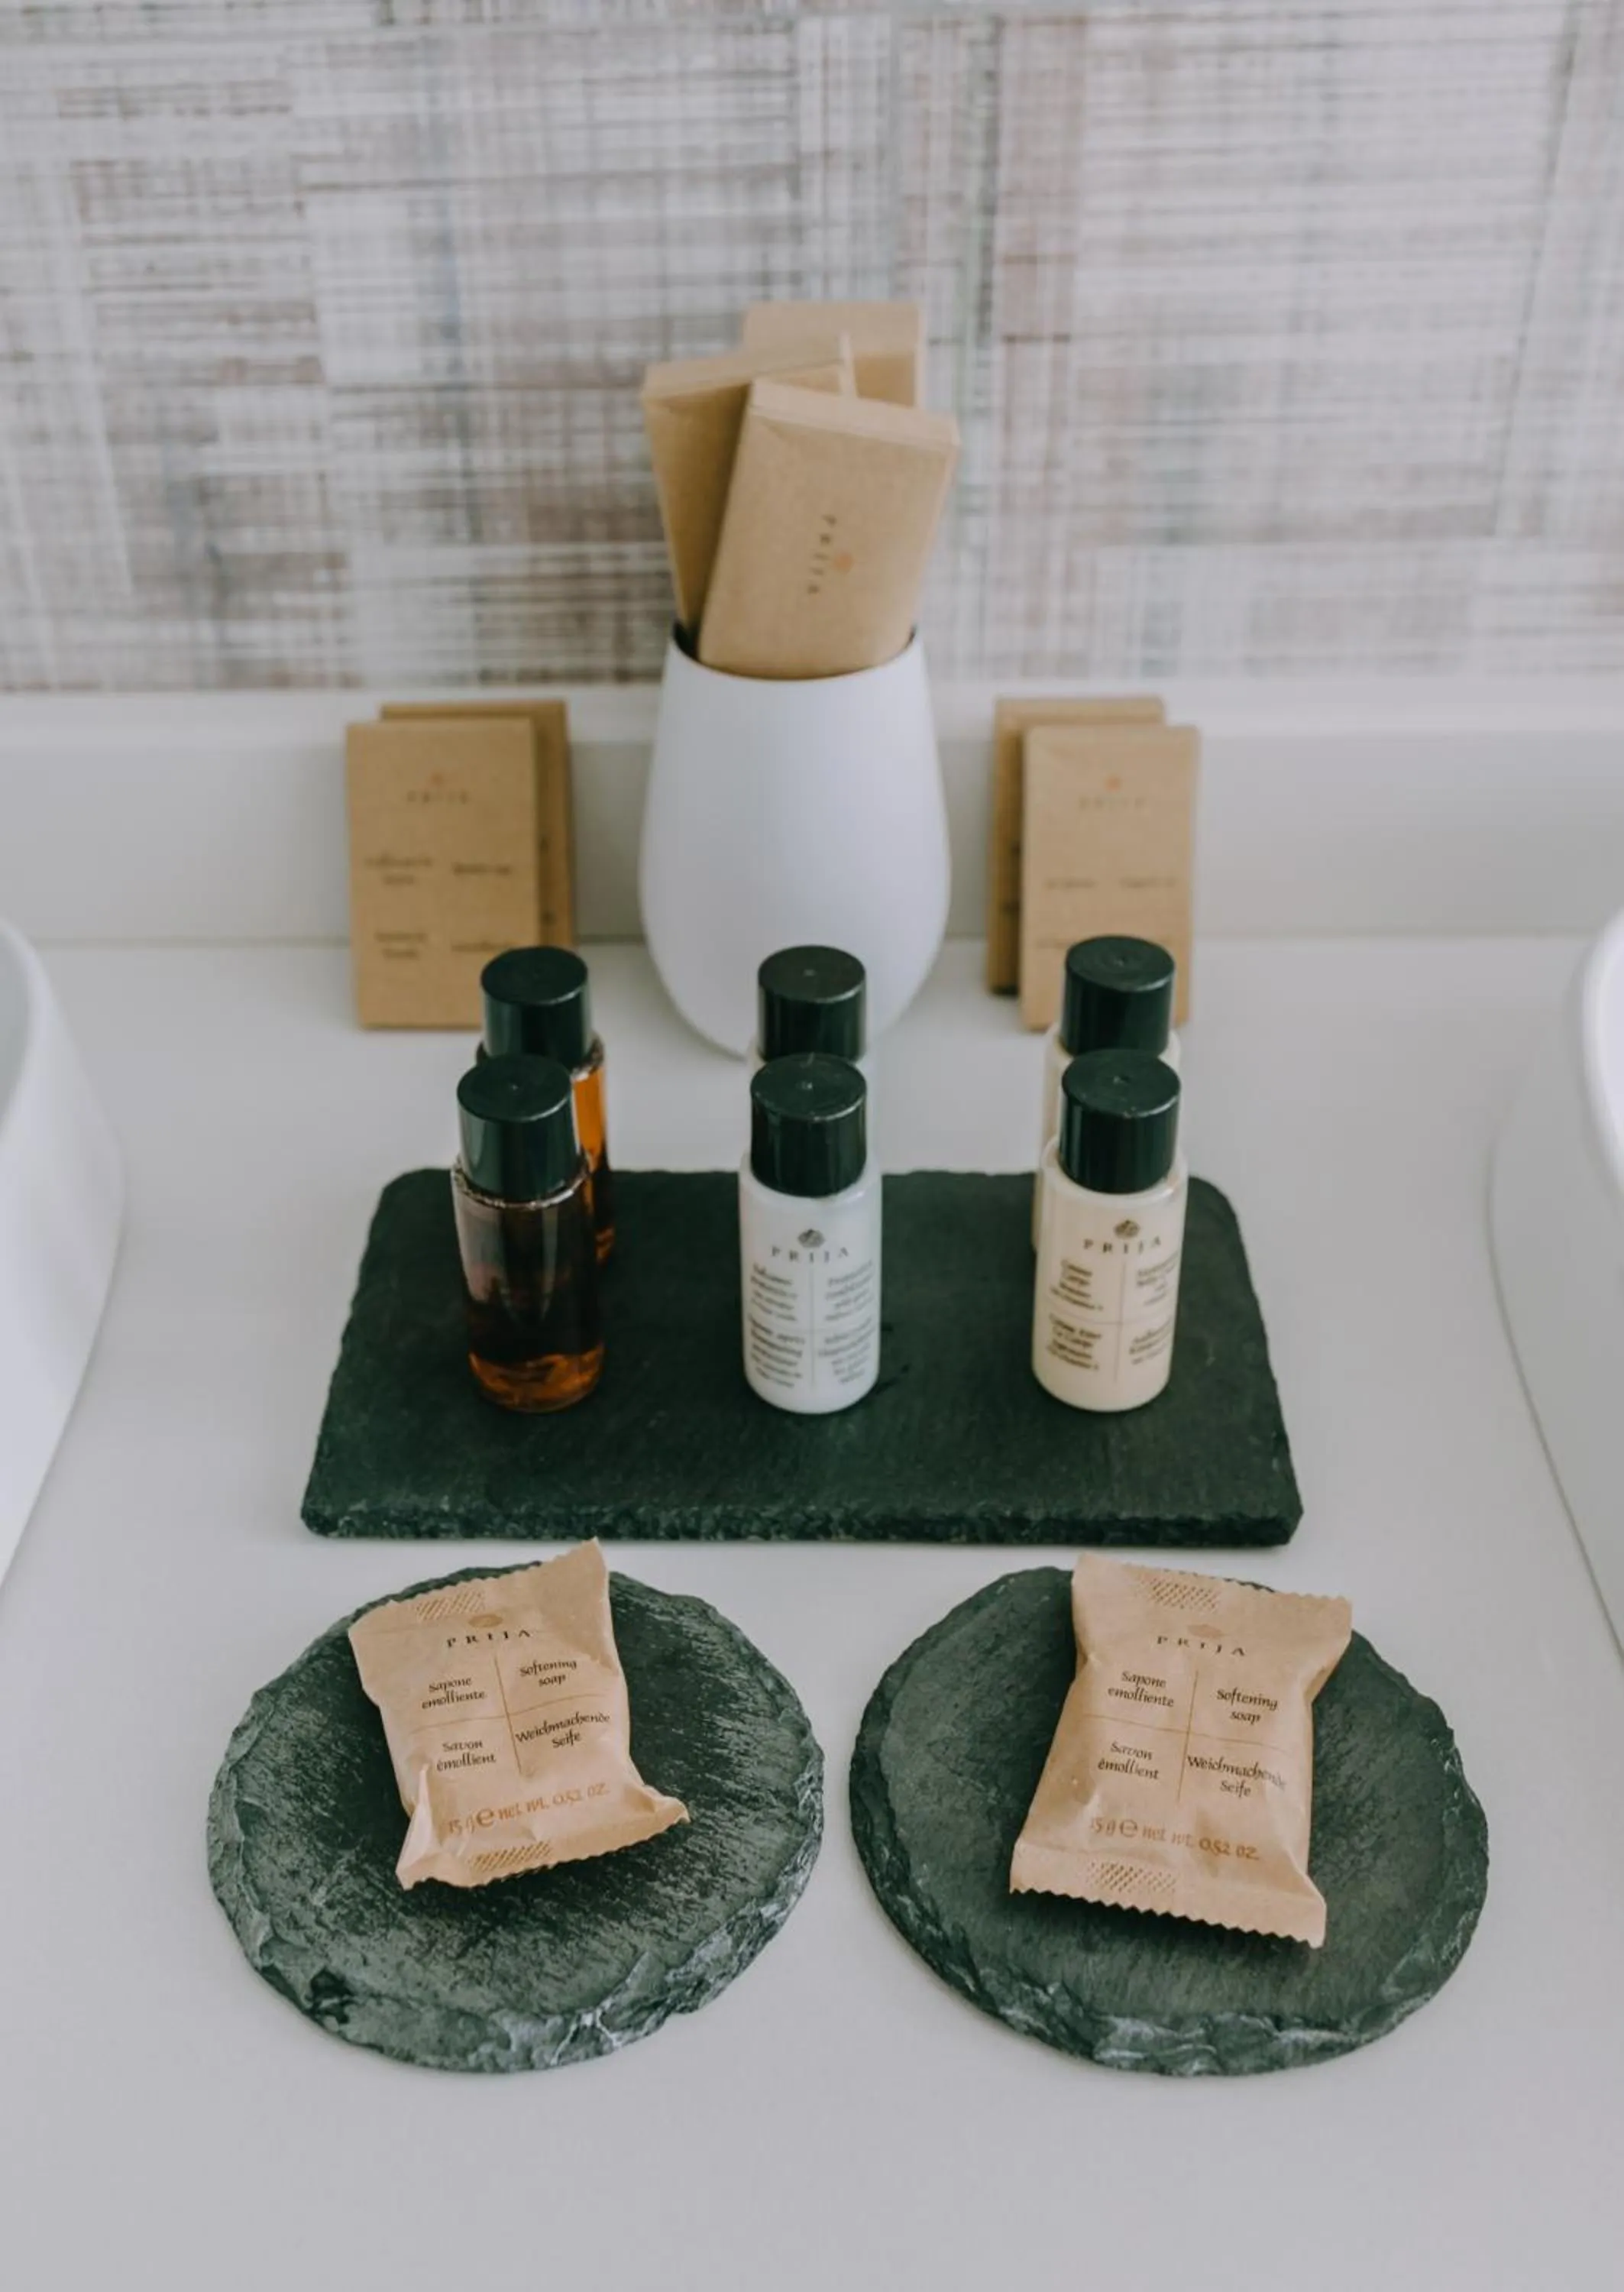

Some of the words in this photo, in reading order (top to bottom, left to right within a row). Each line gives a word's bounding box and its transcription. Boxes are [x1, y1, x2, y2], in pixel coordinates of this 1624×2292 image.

[519, 1659, 577, 1677] Softening
[429, 1677, 472, 1694] Sapone
[539, 1674, 566, 1687] soap
[1121, 1671, 1166, 1688] Sapone
[421, 1689, 486, 1710] emolliente
[1108, 1687, 1174, 1708] emolliente
[1217, 1687, 1278, 1711] Softening
[515, 1711, 610, 1743] Weichmachende
[1231, 1711, 1261, 1725] soap
[442, 1740, 483, 1752] Savon
[552, 1729, 581, 1749] Seife
[1098, 1758, 1159, 1779] émollient
[1220, 1779, 1251, 1798] Seife
